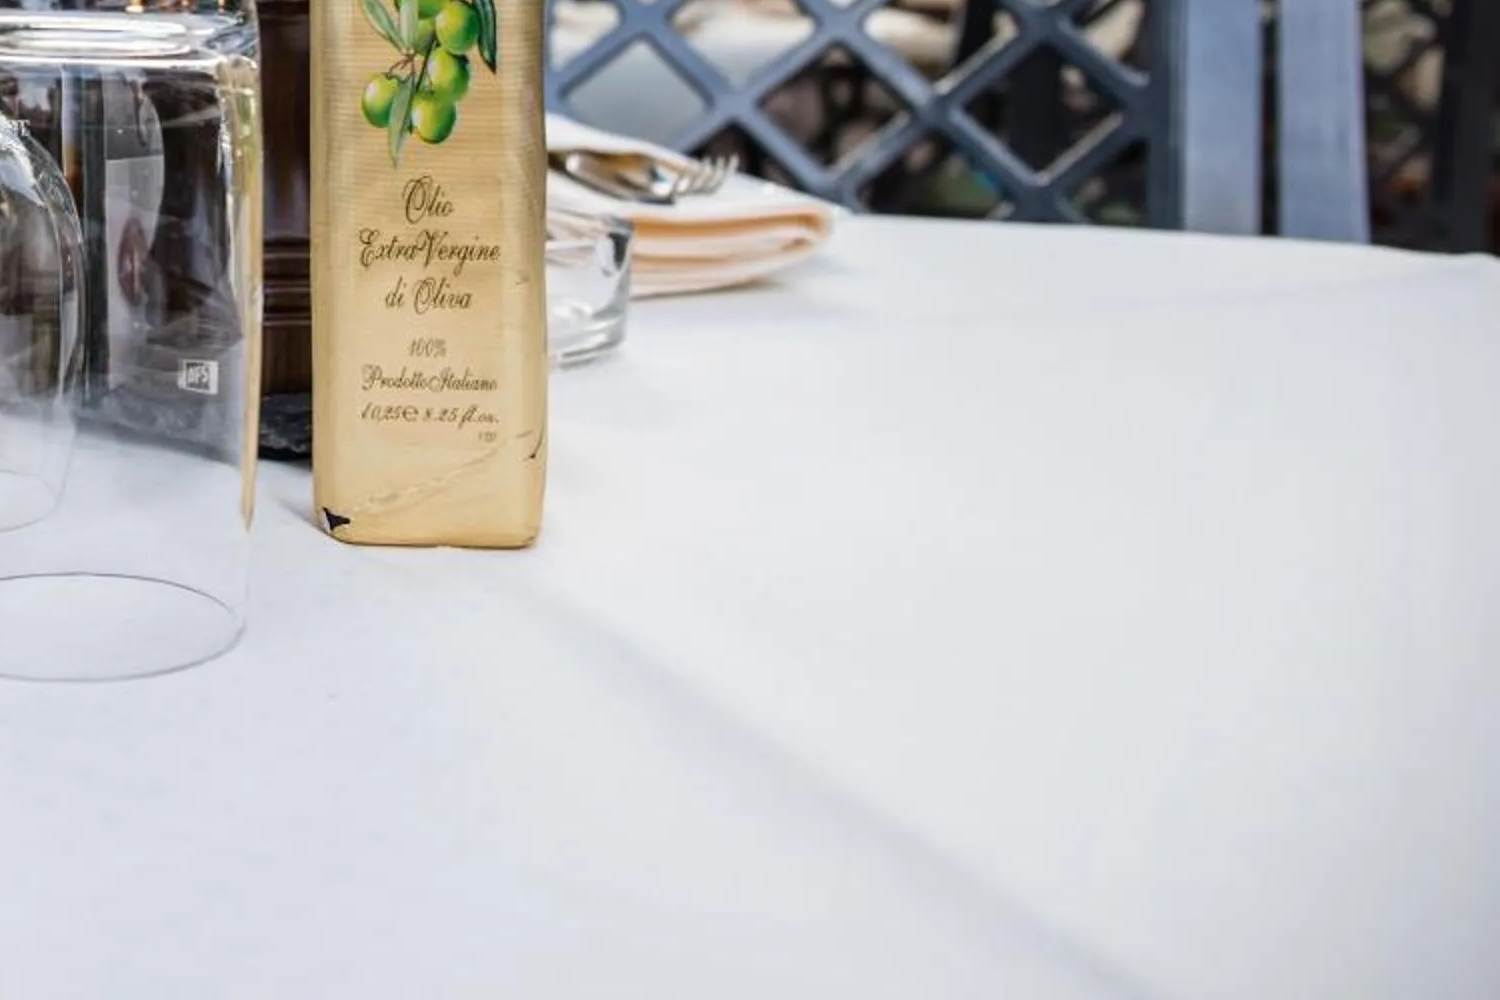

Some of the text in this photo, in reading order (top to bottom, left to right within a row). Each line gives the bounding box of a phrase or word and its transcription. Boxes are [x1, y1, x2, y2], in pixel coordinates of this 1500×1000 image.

[402, 175, 454, 224] Olio
[359, 228, 500, 277] Extra Vergine
[385, 275, 473, 315] di Oliva
[409, 337, 447, 358] 100%
[361, 363, 498, 393] Prodotto Italiano
